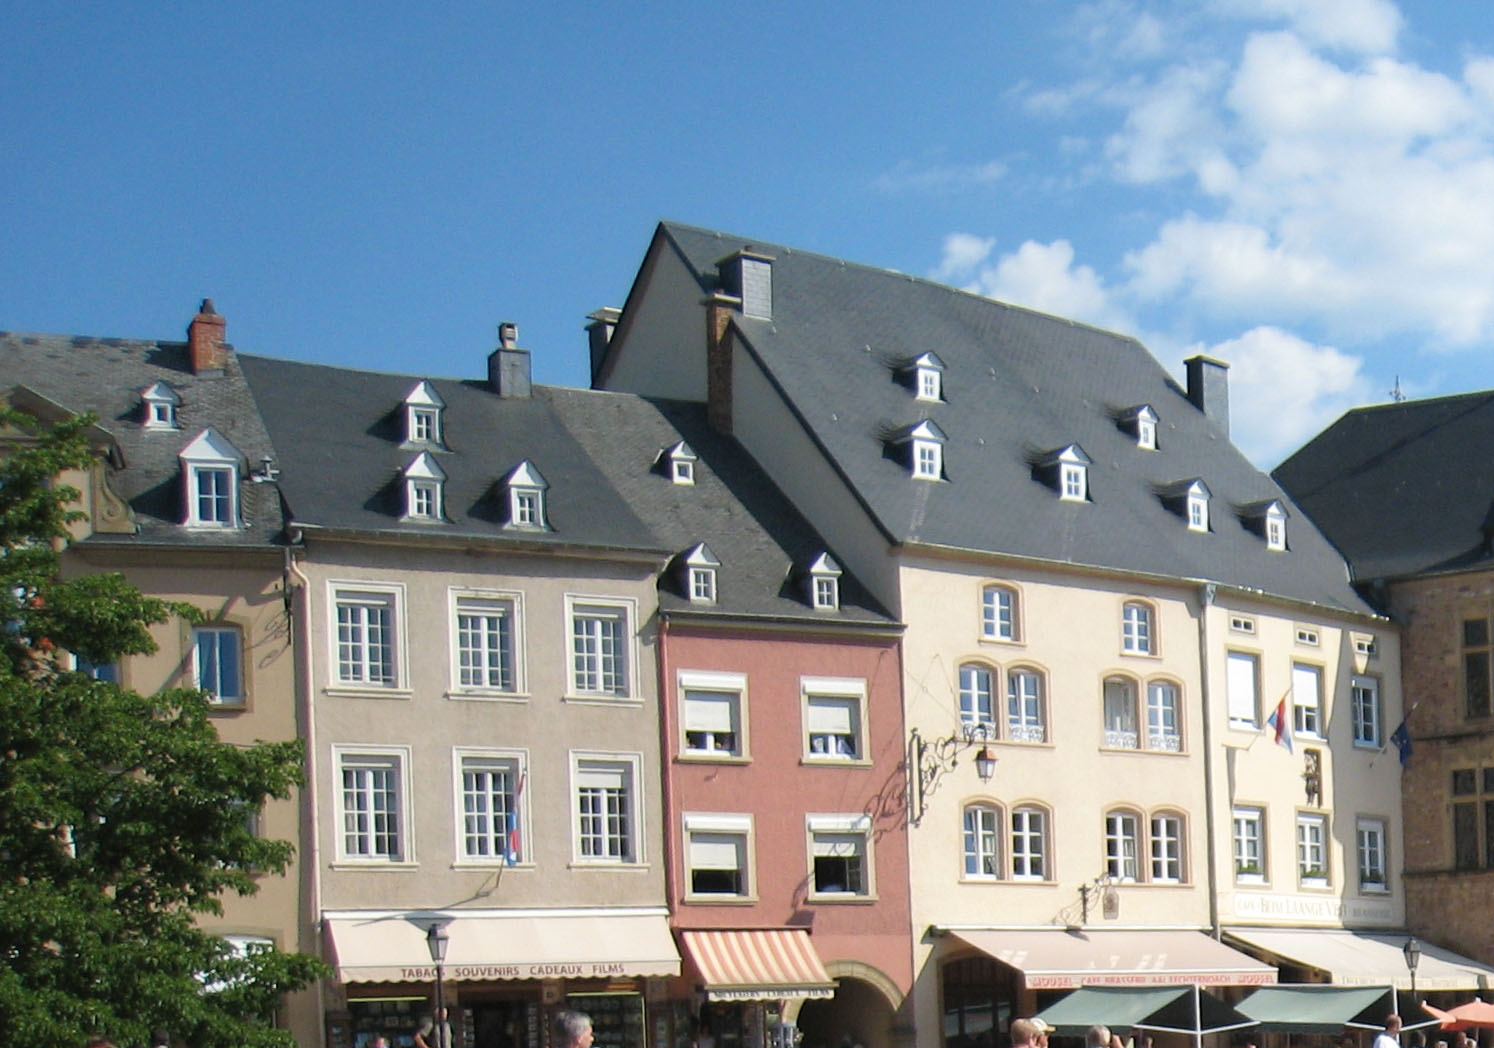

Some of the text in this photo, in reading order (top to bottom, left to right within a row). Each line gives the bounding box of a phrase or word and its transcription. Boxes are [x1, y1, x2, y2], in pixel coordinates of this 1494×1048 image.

[455, 966, 520, 977] SOUVENIRS
[529, 965, 583, 975] CADEAUX
[592, 963, 625, 974] FILMS
